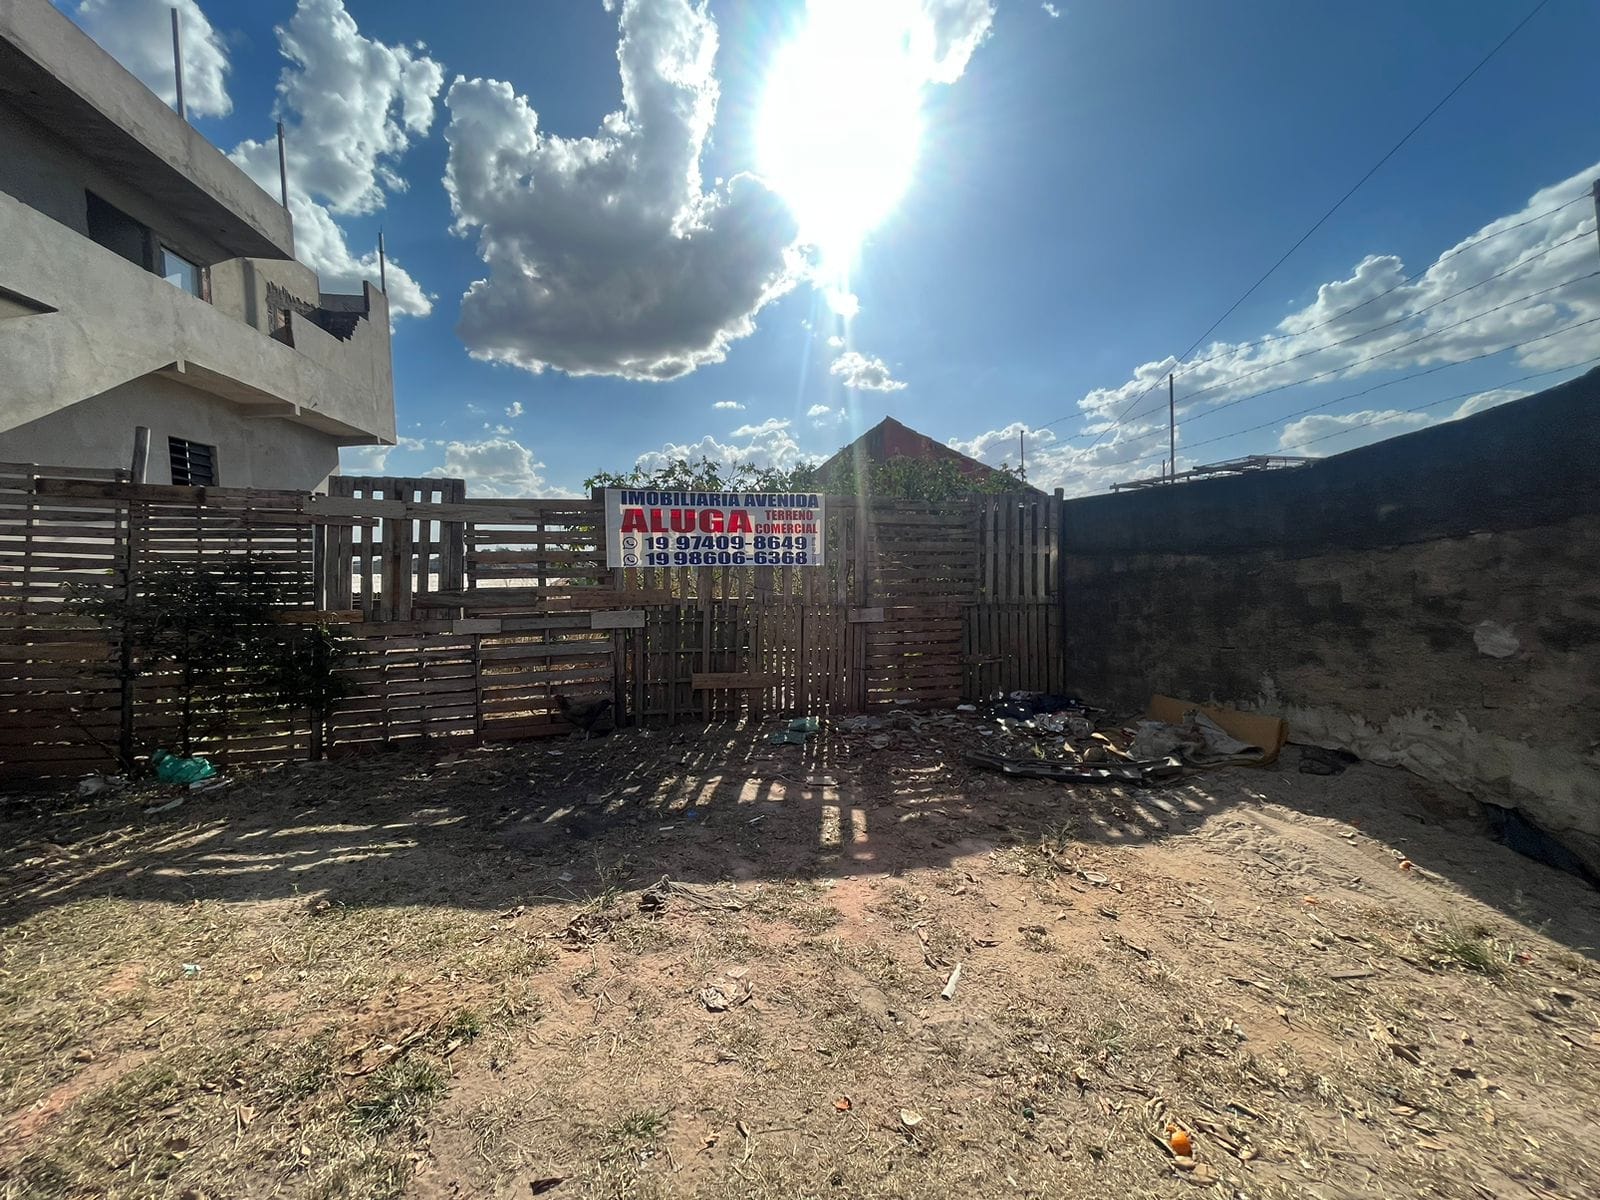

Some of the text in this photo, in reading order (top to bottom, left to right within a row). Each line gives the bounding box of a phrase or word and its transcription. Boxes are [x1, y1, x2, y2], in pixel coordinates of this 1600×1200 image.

[621, 491, 818, 508] IMOBILIARIA AVENIDA
[621, 508, 752, 533] ALUGA
[765, 510, 813, 520] TERRENO
[755, 523, 818, 534] COMERCIAL
[645, 537, 669, 549] 19
[676, 536, 807, 549] 97409-8649
[645, 552, 807, 565] 19 98606-6368
